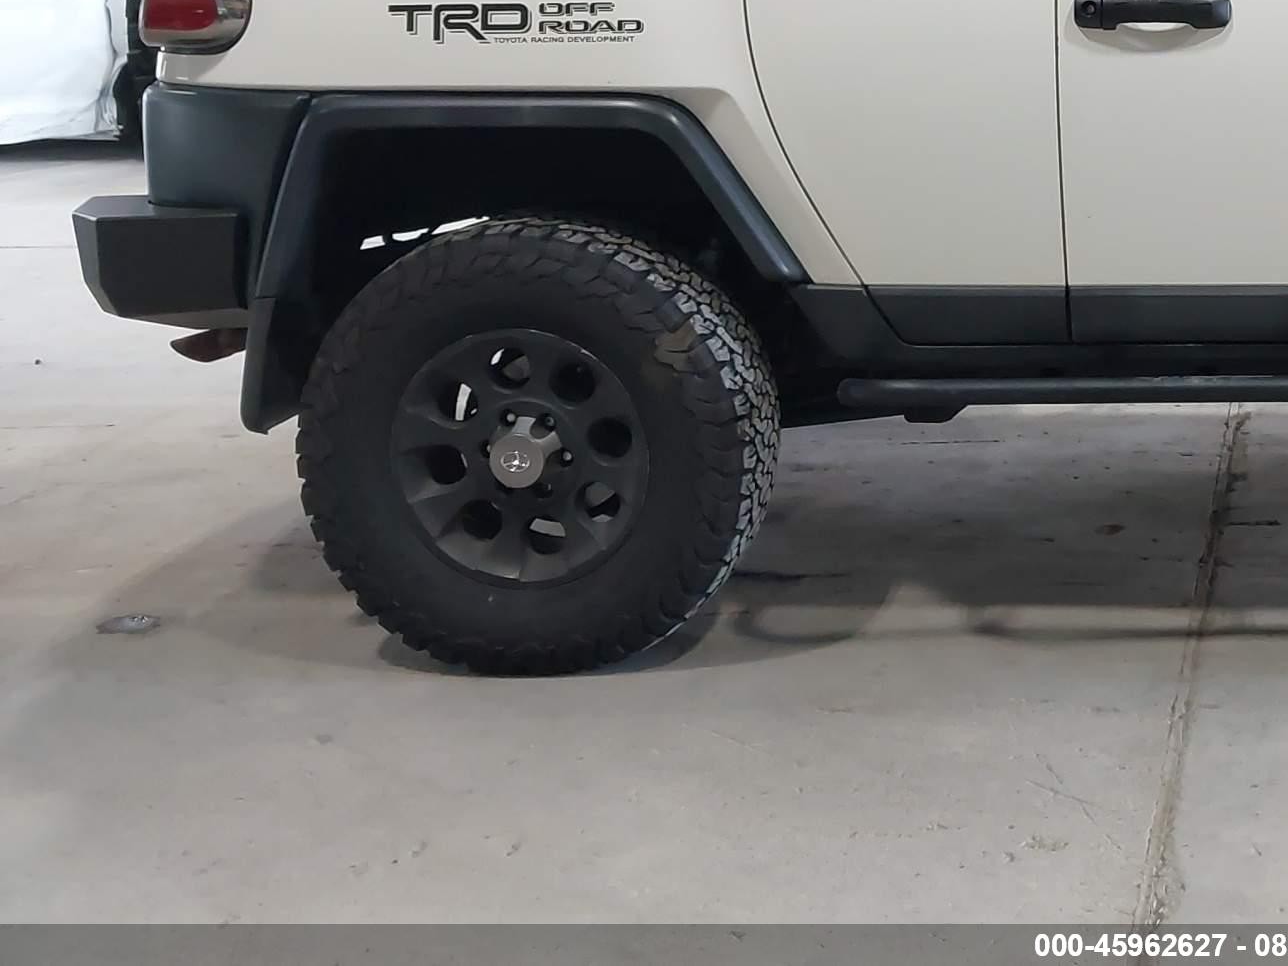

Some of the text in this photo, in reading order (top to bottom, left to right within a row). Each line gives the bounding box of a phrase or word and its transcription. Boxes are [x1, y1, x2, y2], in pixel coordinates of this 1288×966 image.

[539, 2, 616, 17] OFF
[388, 3, 532, 44] TRD
[539, 19, 645, 35] ROAD
[494, 35, 635, 44] TOYOTA RACING DEVELOPMENT
